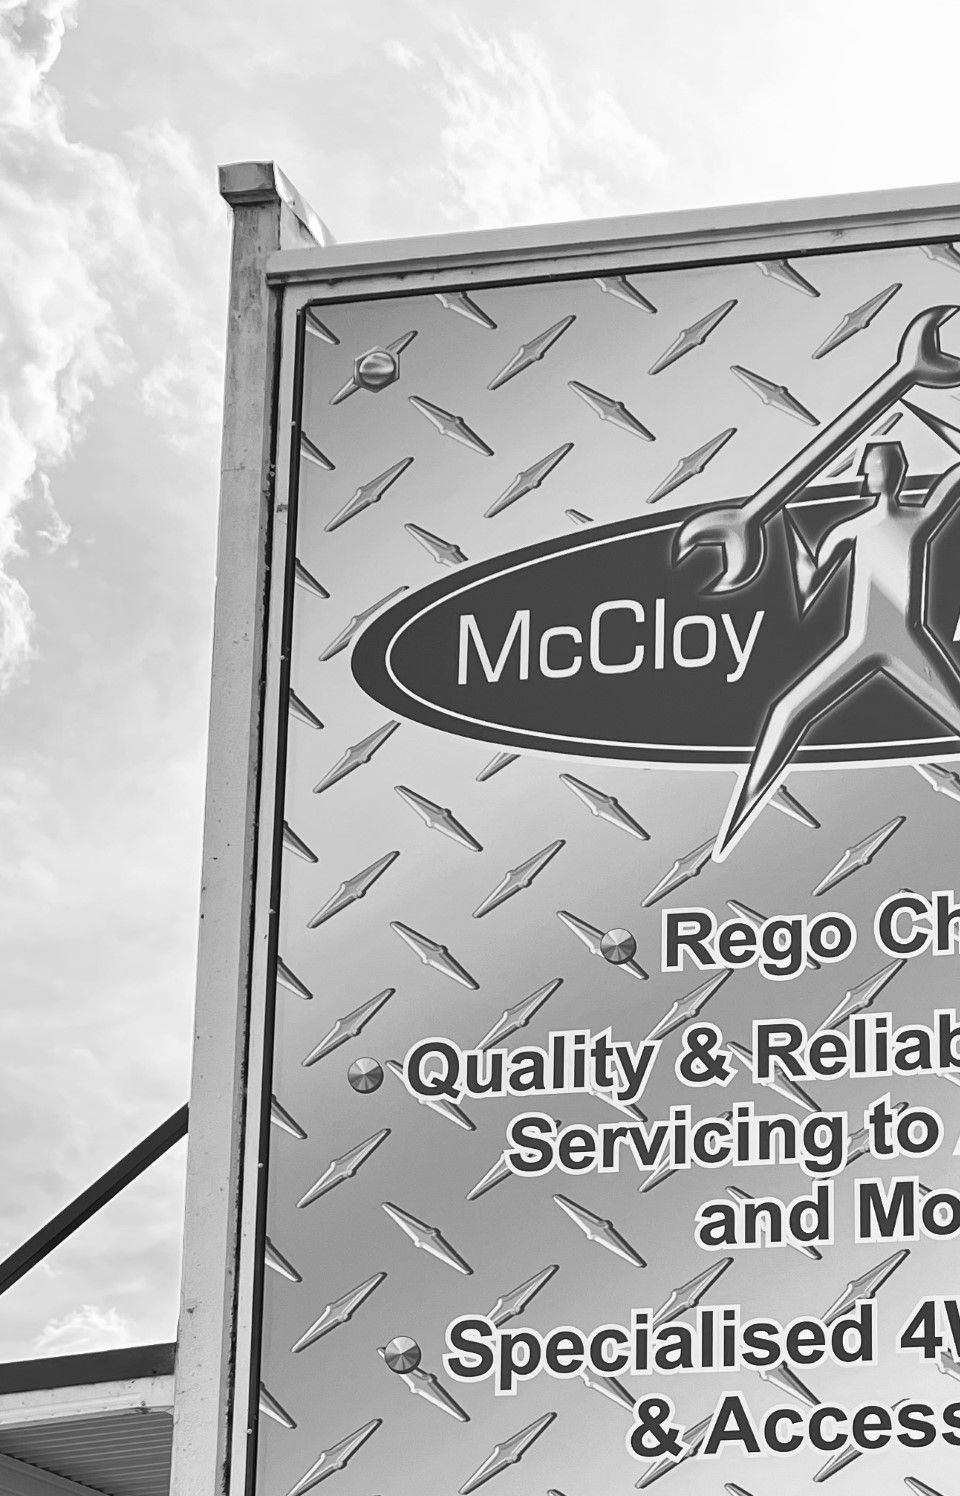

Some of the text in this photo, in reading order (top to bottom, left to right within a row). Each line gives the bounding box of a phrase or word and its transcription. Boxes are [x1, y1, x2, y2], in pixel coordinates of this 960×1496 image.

[457, 598, 765, 685] McCloy
[665, 910, 852, 976] Rego
[407, 1033, 656, 1100] Quality
[679, 1025, 731, 1084] &
[508, 1106, 845, 1173] Servicing
[869, 1099, 939, 1155] to
[699, 1182, 831, 1246] and
[447, 1304, 874, 1391] Specialised
[630, 1398, 683, 1459] &
